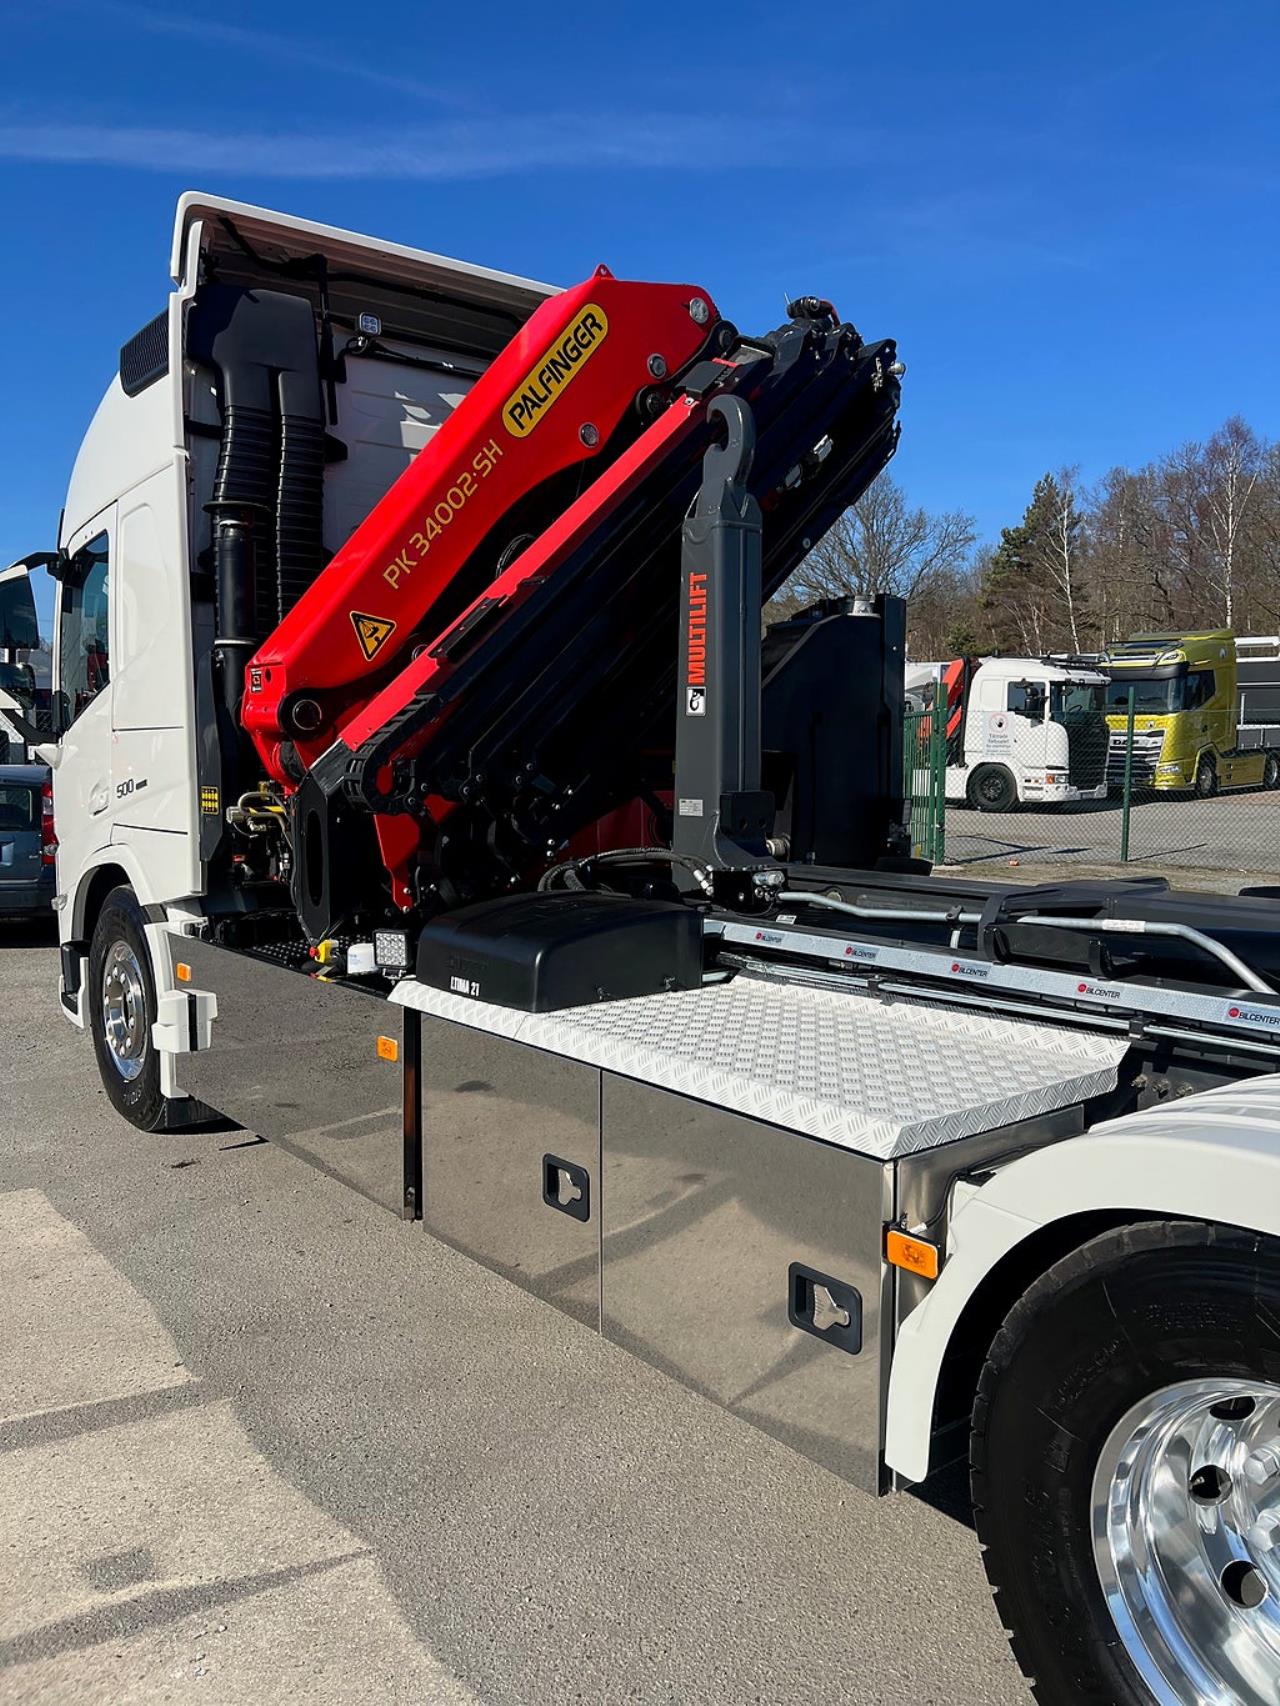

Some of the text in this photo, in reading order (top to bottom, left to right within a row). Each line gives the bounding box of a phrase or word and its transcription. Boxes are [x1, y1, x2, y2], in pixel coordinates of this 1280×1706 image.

[508, 313, 604, 431] PALFINGER
[383, 548, 418, 590] PK
[688, 572, 707, 684] MULTILIFT
[116, 778, 135, 799] 500
[958, 967, 988, 977] BILCENTER
[471, 981, 480, 996] 21
[1085, 988, 1121, 999] BILCENTER
[1239, 1011, 1280, 1026] BILCENTER
